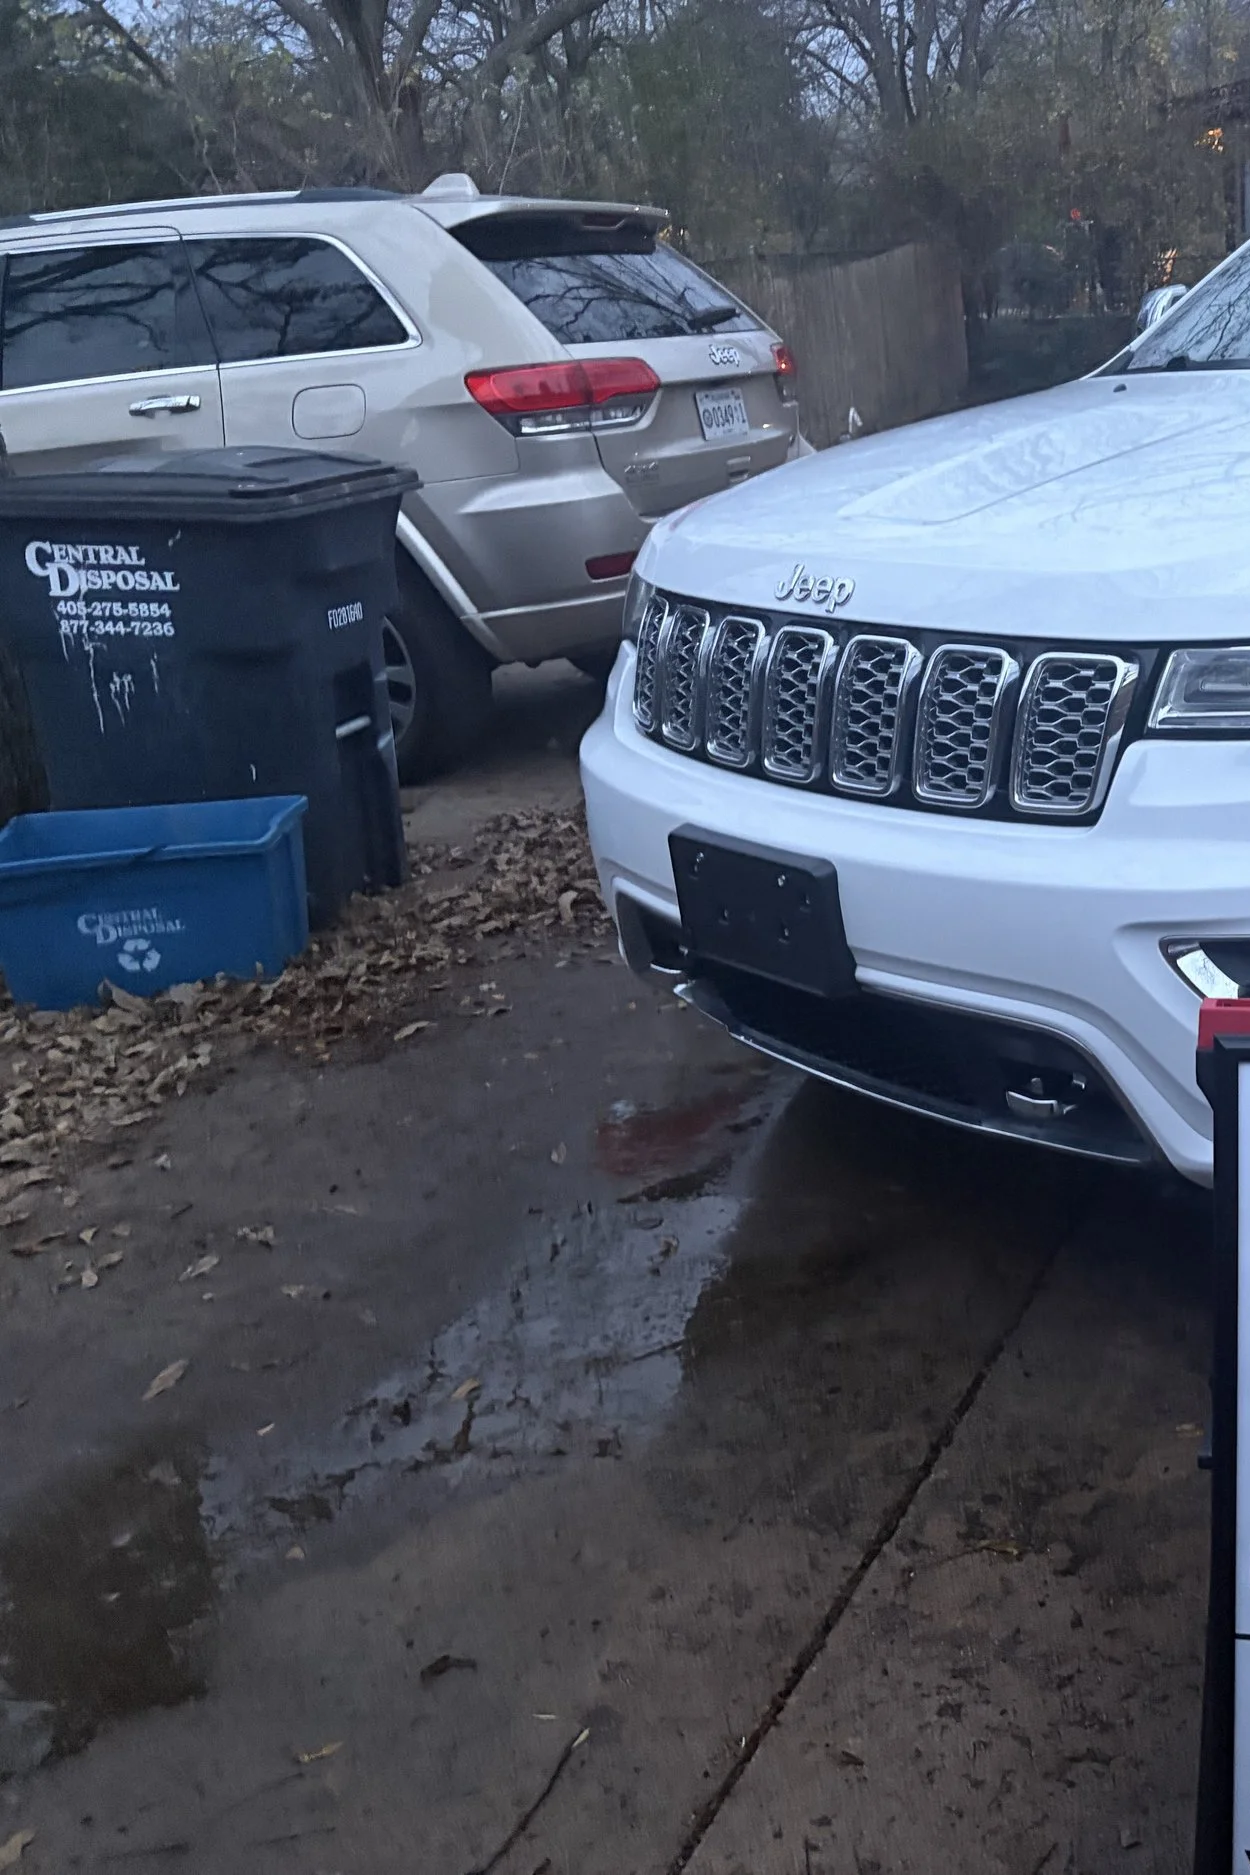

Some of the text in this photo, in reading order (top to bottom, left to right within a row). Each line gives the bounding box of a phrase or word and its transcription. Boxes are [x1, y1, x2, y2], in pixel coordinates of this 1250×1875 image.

[708, 344, 740, 367] Jeep
[25, 541, 145, 577] CENTRAL
[48, 562, 180, 597] DISPOSAL
[775, 562, 856, 614] Jeep
[57, 600, 172, 618] 405-275-5854
[59, 619, 175, 637] 877-344-7236
